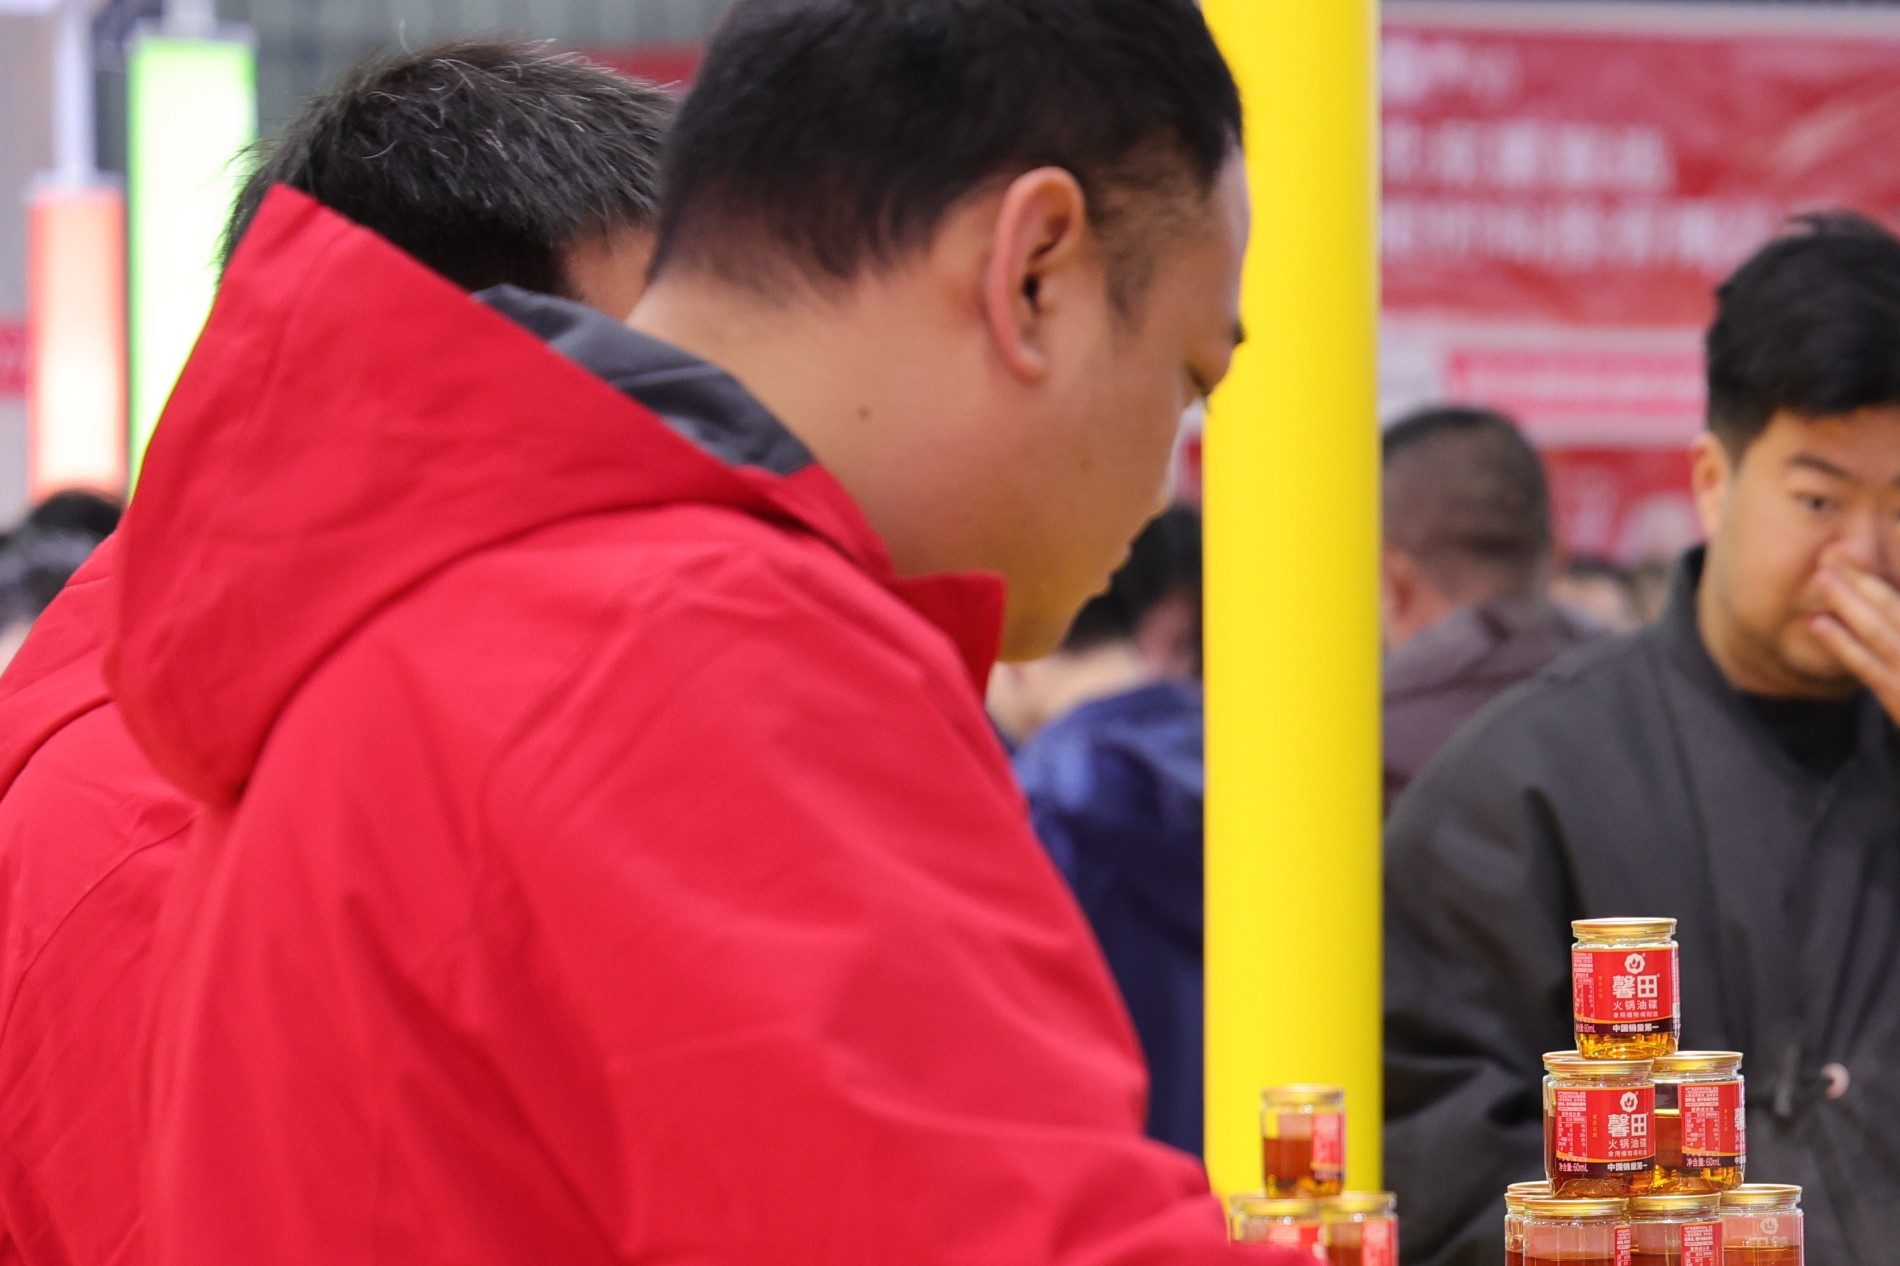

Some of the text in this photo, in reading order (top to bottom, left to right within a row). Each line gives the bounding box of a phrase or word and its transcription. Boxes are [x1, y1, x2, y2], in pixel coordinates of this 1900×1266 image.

[1612, 975, 1658, 998] 馨田
[1613, 1000, 1658, 1011] 火锅油碟
[1608, 1114, 1647, 1138] 馨田
